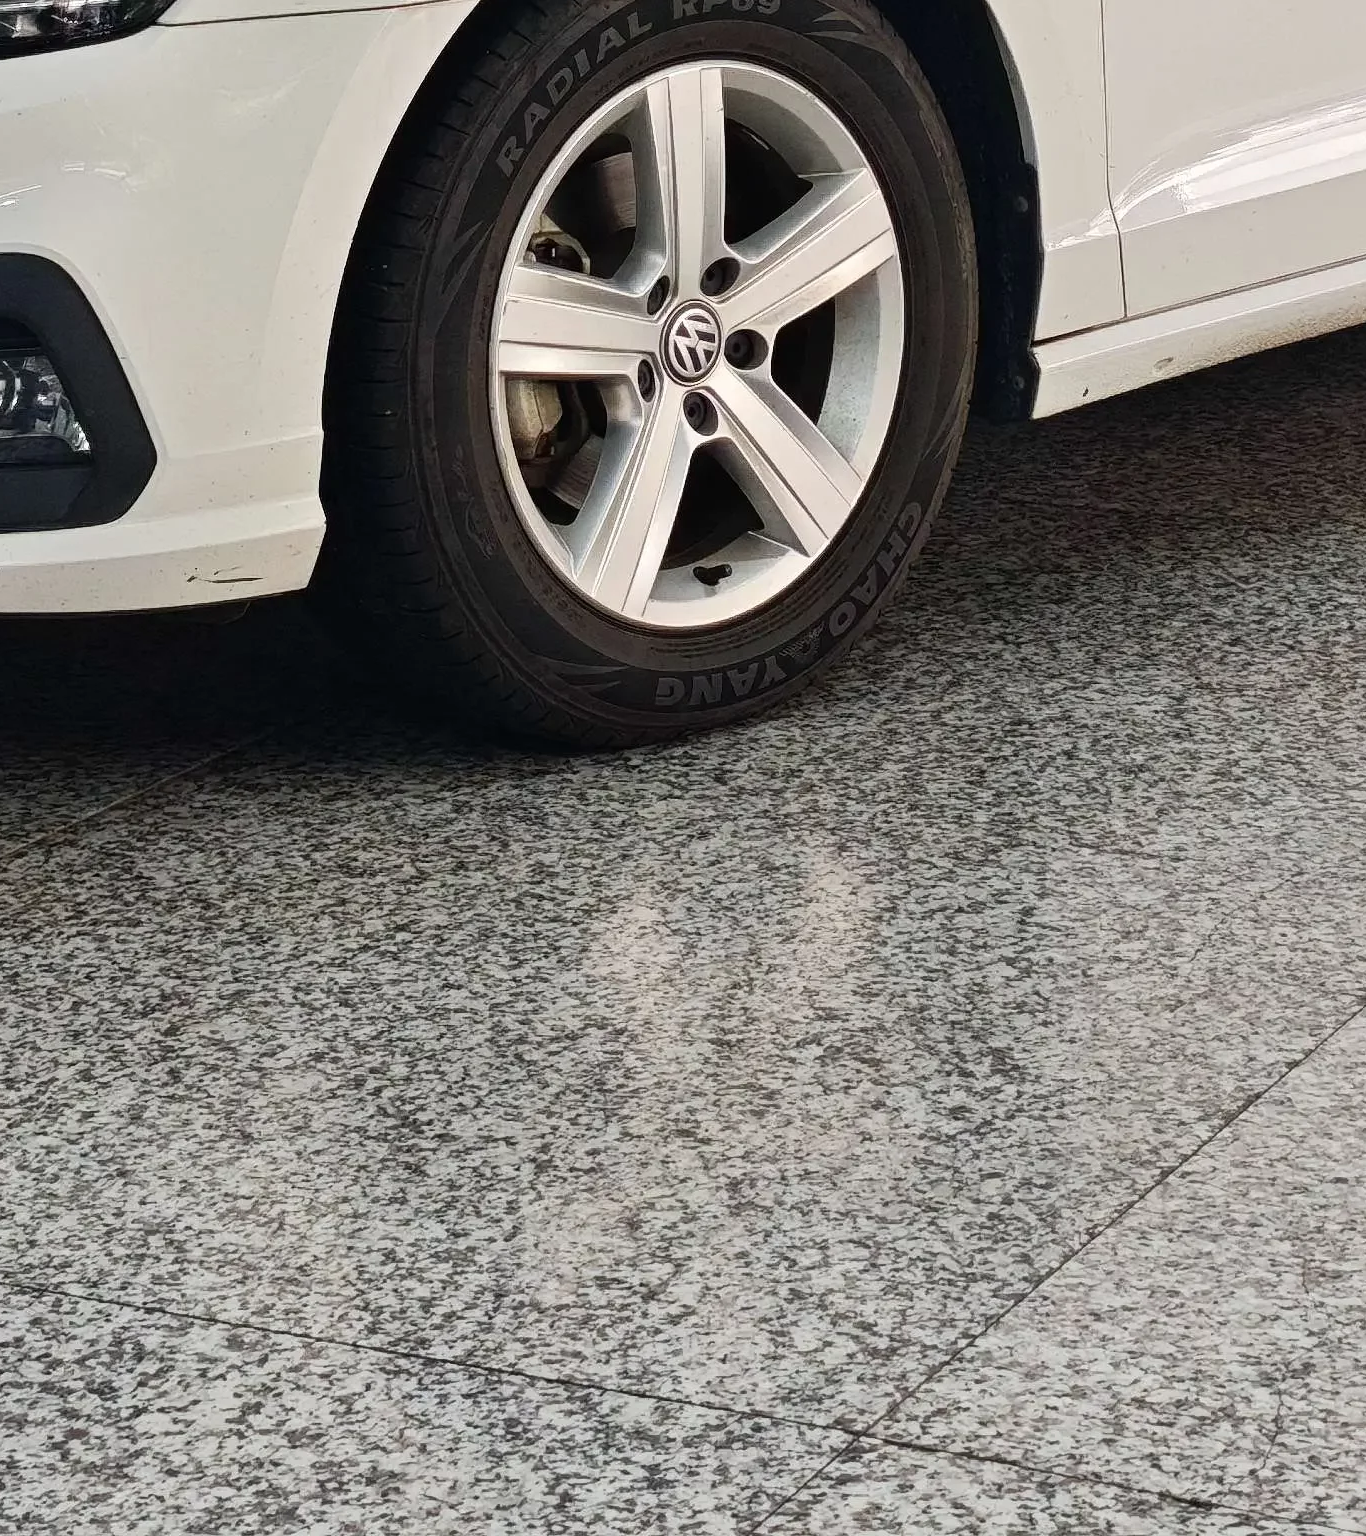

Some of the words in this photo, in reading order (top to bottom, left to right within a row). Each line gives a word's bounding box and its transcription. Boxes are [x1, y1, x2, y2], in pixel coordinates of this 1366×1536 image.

[495, 10, 654, 178] RADIAL
[828, 501, 923, 638] CHAO
[654, 655, 787, 707] YANG
